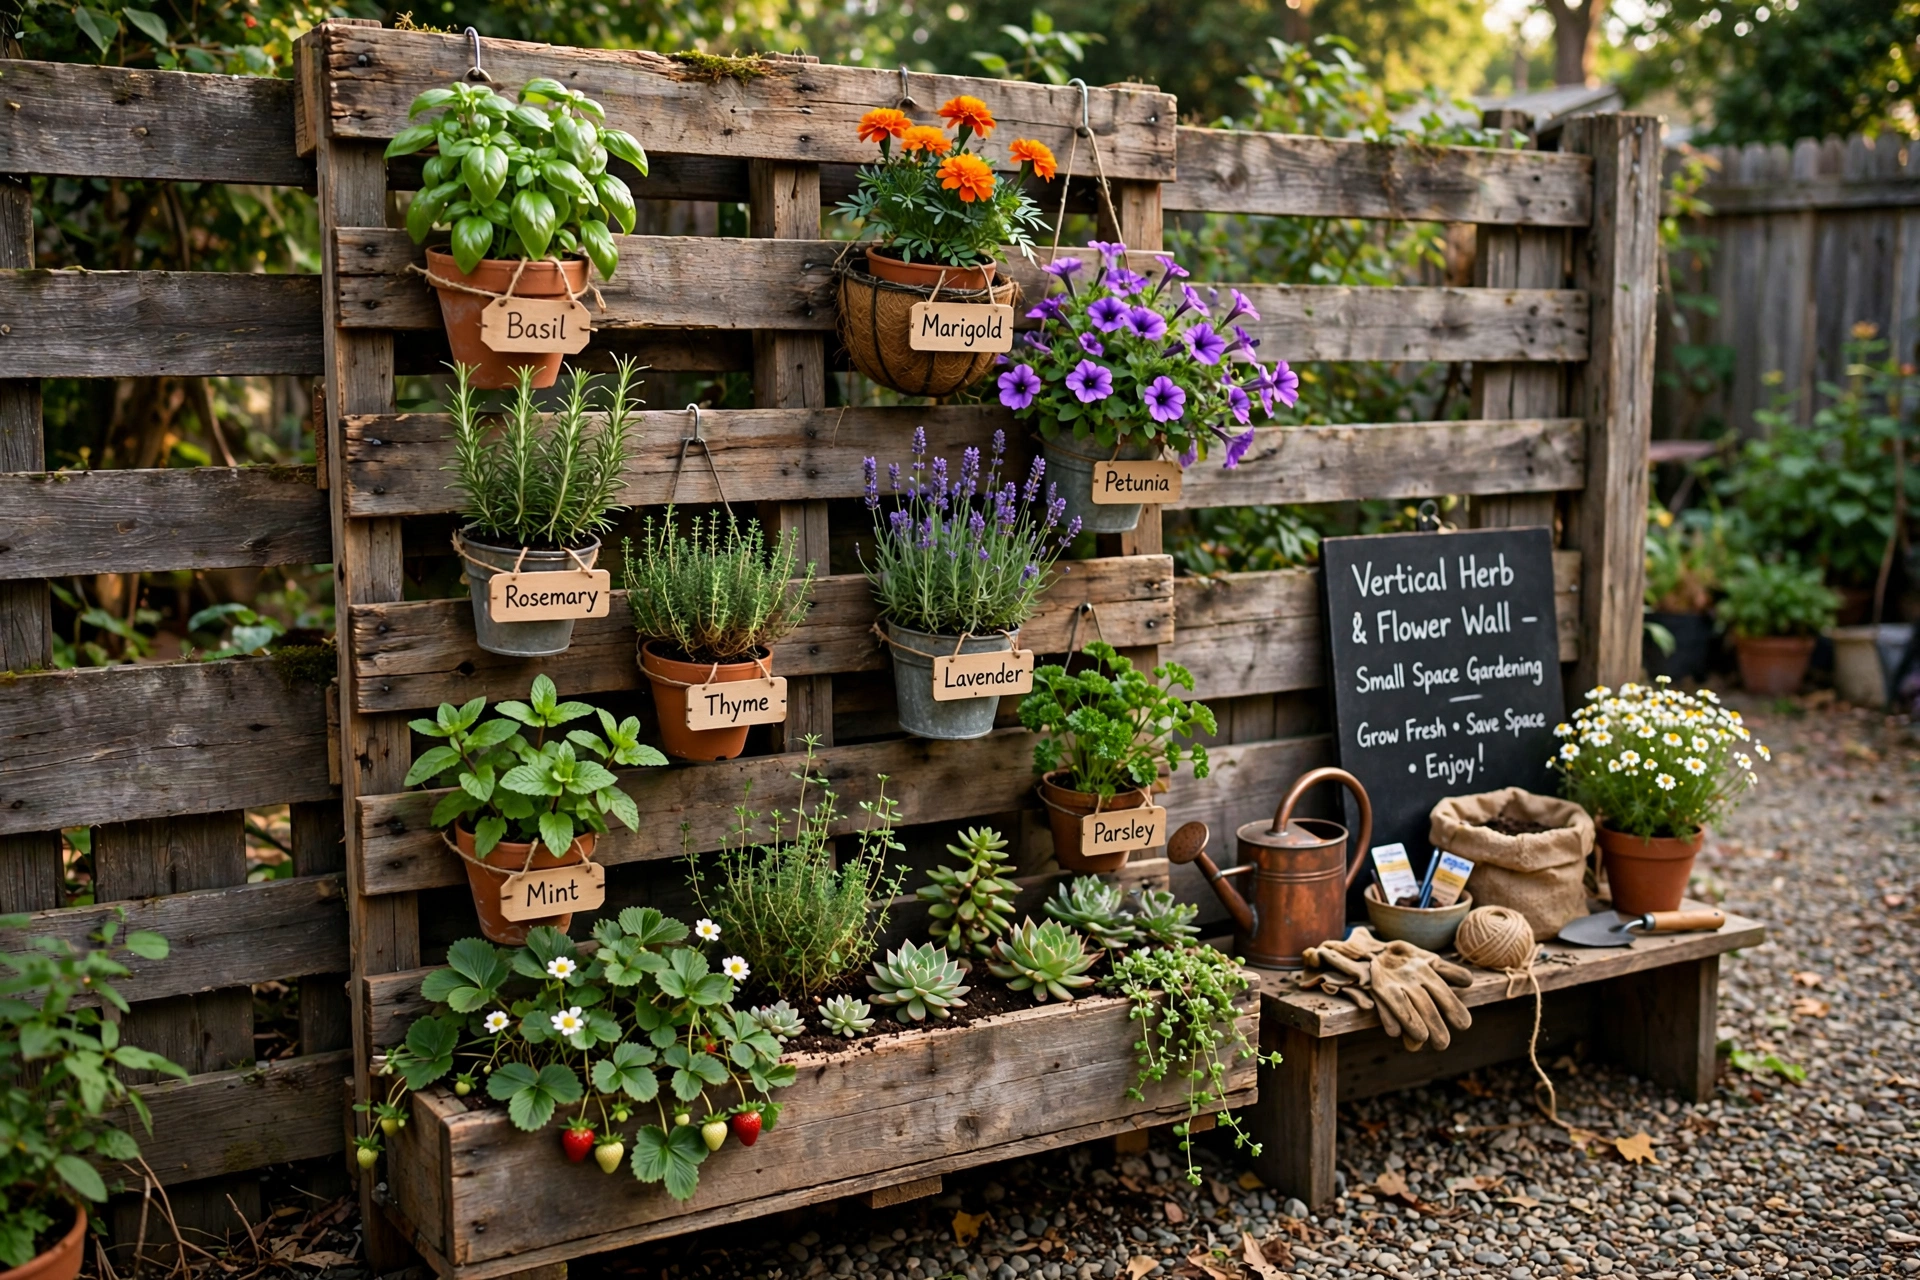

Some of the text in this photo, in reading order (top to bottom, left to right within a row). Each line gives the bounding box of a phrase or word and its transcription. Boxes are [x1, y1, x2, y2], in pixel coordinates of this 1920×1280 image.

[507, 311, 566, 340] Basil
[921, 313, 1002, 347] Marigold
[1105, 470, 1170, 492] Petunia
[1351, 552, 1514, 597] Vertical Herb
[505, 584, 598, 613] Rosemary
[1352, 612, 1368, 644] &
[1376, 609, 1451, 644] Flower
[1461, 600, 1511, 635] Wall
[944, 662, 1024, 688] Lavender
[1355, 655, 1543, 695] Small Space Gardening
[704, 692, 770, 723] Thyme
[1357, 708, 1546, 748] Grow Fresh Save Space
[1425, 742, 1485, 785] Enjoy!
[1094, 818, 1155, 846] Parsley
[526, 879, 579, 907] Mint
